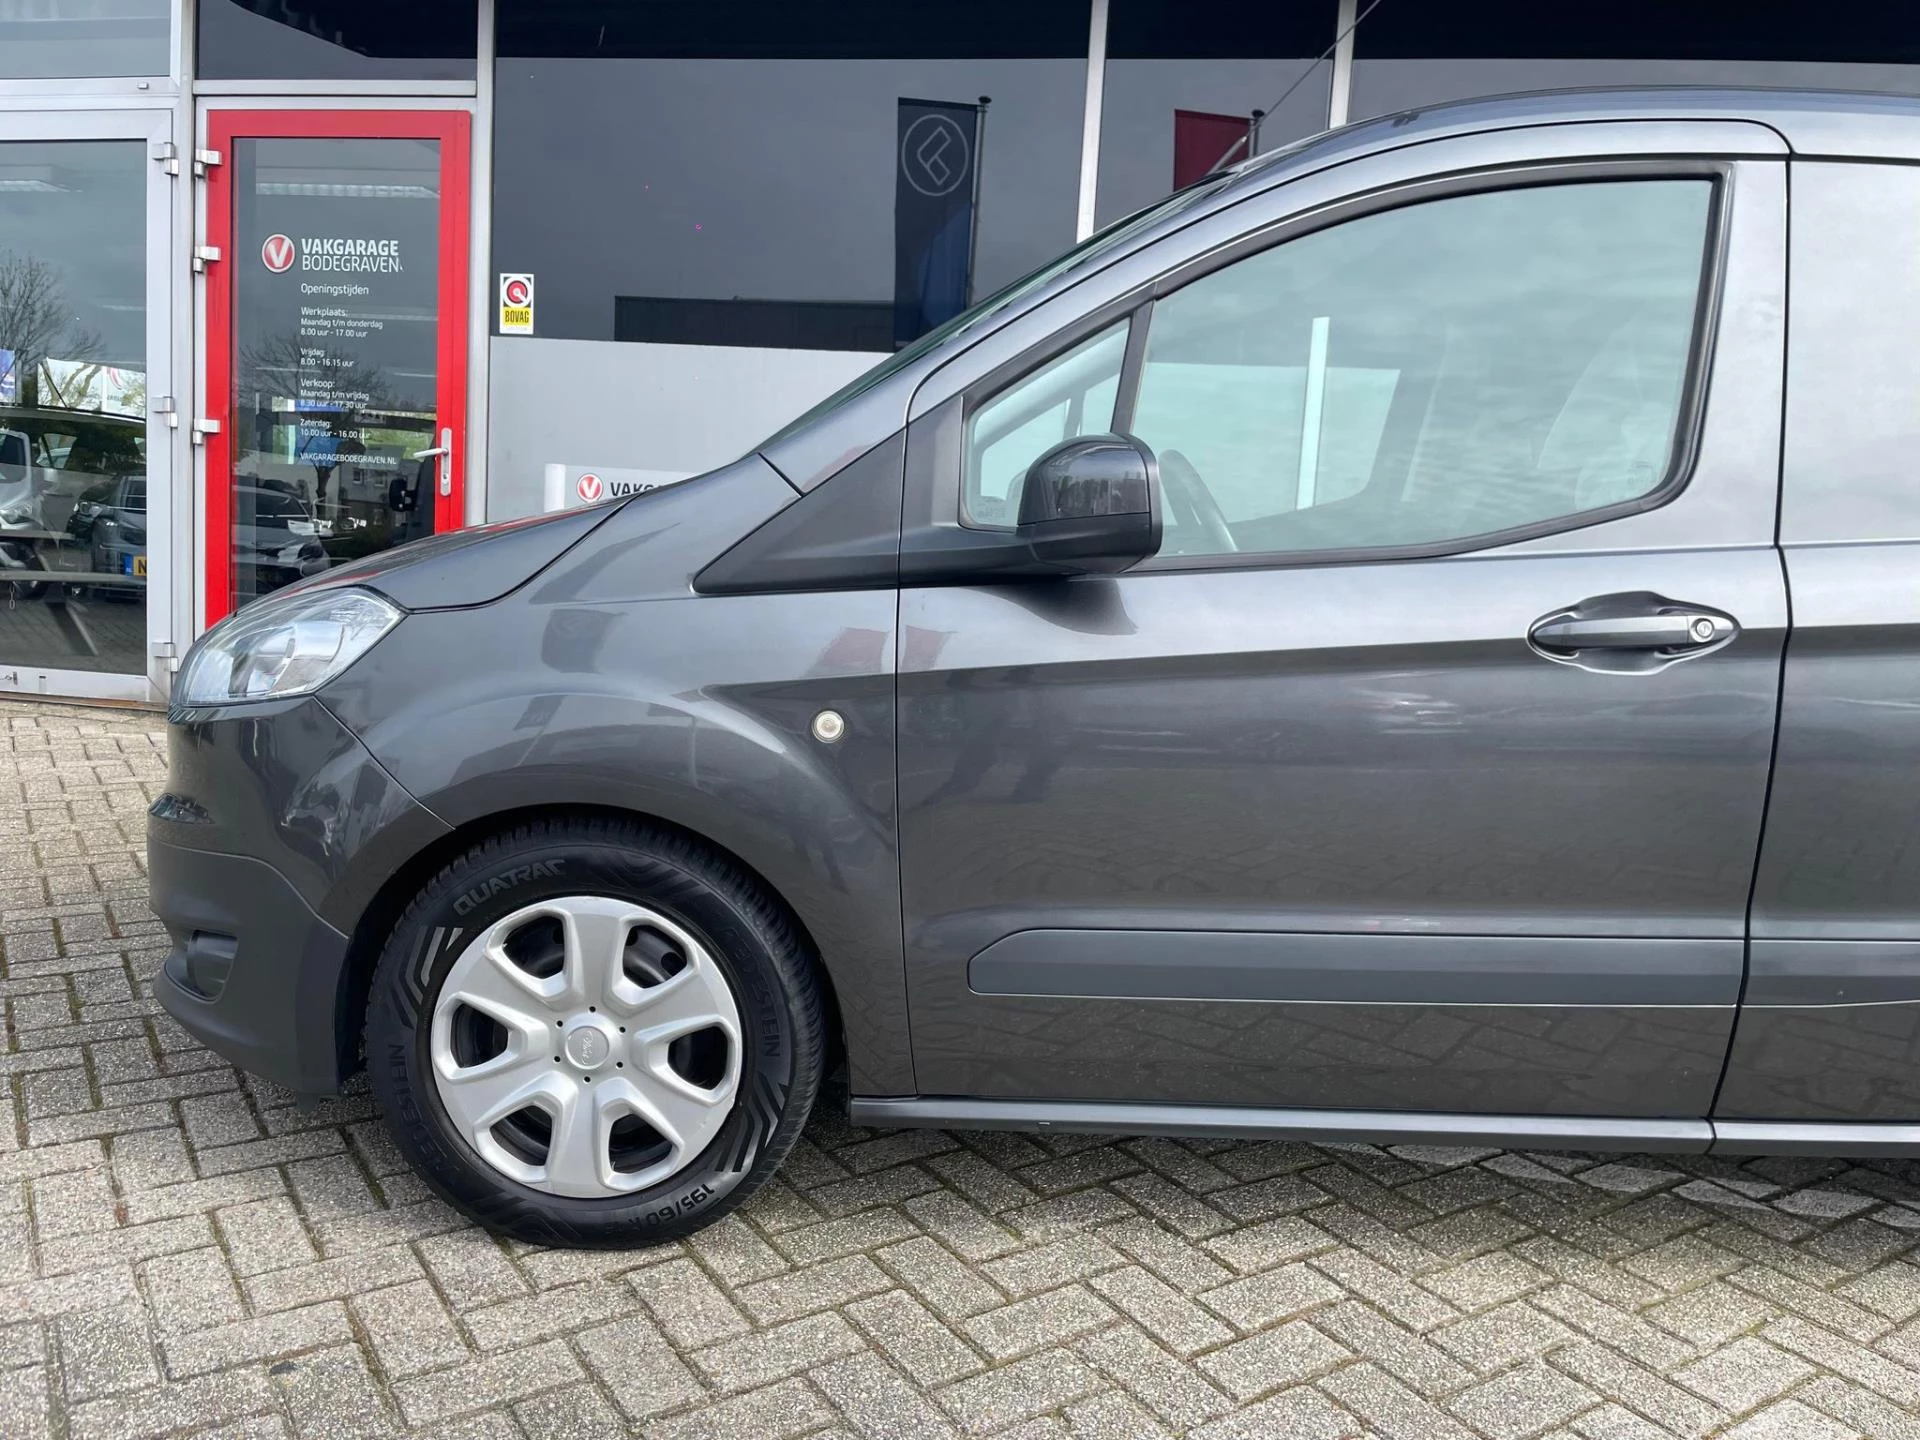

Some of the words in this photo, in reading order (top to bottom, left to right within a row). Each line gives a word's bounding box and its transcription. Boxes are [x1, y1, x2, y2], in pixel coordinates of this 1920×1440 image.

[301, 238, 399, 256] VAKGARAGE
[301, 283, 369, 296] Openingstijden
[301, 307, 348, 317] Werkplaats:
[505, 310, 530, 323] BOVAG
[301, 318, 331, 328] Maandag
[332, 319, 346, 327] t/m
[346, 319, 383, 329] donderdag
[301, 328, 315, 336] 8.00
[336, 329, 355, 338] 17.00
[301, 358, 315, 366] 8.00
[322, 359, 341, 367] 16.15
[301, 378, 335, 389] Verkoop:
[301, 389, 331, 399] Maandag
[332, 391, 345, 399] t/m
[345, 391, 370, 401] vrijdag
[300, 418, 332, 428] Zaterdag:
[301, 429, 319, 437] 10.00
[339, 430, 359, 438] 16.00
[301, 453, 397, 465] VAKGARAGEBODEGRAVEN.NL
[452, 858, 567, 917] QUATRAC
